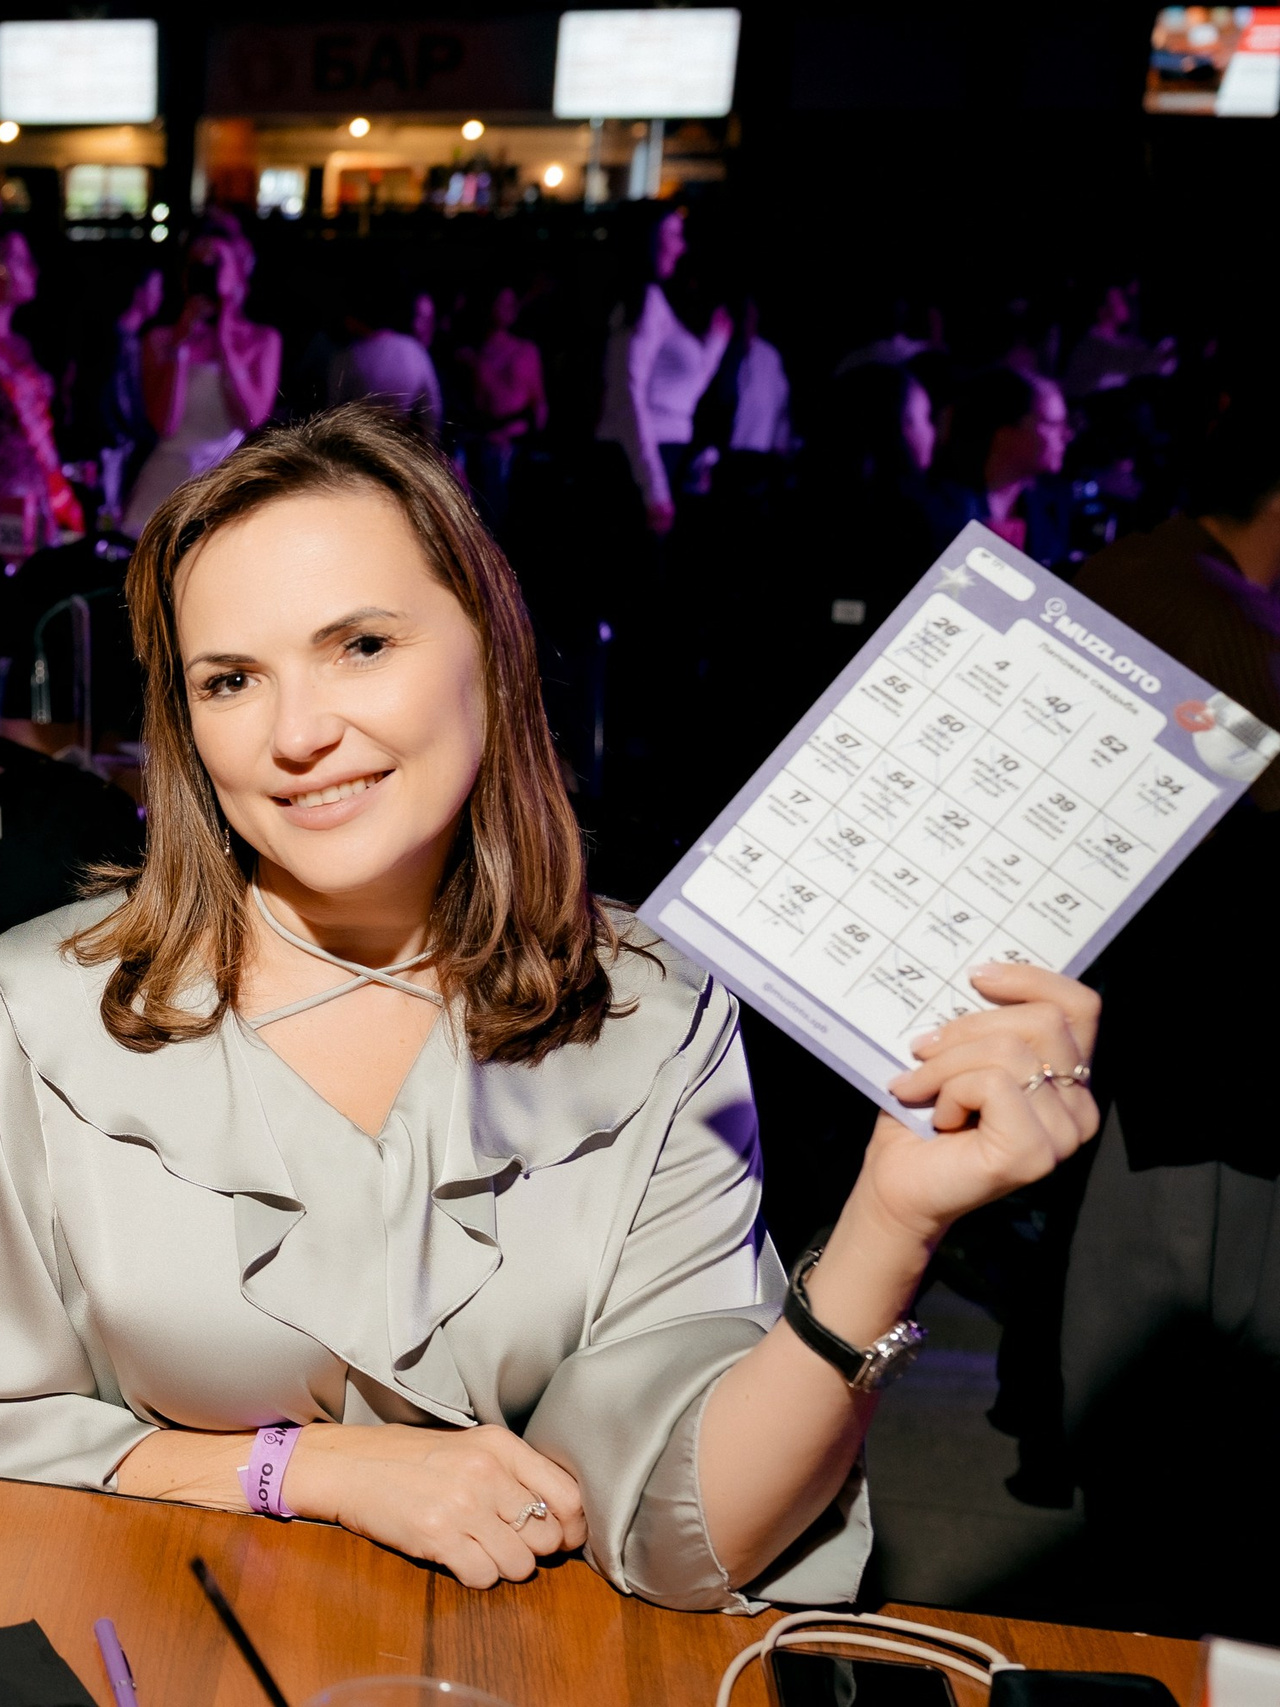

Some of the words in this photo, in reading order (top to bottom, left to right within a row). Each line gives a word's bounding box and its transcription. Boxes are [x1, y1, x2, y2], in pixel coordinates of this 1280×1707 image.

[931, 617, 962, 637] 26
[1055, 614, 1162, 695] MUZLOTO
[994, 660, 1011, 671] 4
[882, 674, 912, 694] 55
[1044, 696, 1072, 714] 40
[937, 713, 966, 733] 50
[1099, 734, 1128, 755] 52
[996, 753, 1020, 772] 10
[886, 770, 916, 790] 54
[1155, 775, 1185, 796] 34
[789, 789, 812, 804] 17
[1048, 792, 1077, 812] 39
[941, 810, 970, 830] 22
[838, 827, 866, 847] 38
[1103, 833, 1133, 854] 28
[741, 845, 763, 862] 14
[1002, 854, 1021, 867] 3
[893, 867, 919, 886] 31
[790, 884, 818, 903] 45
[952, 911, 971, 924] 8
[843, 923, 870, 943] 56
[896, 964, 925, 981] 27
[258, 1462, 274, 1513] LOTO
